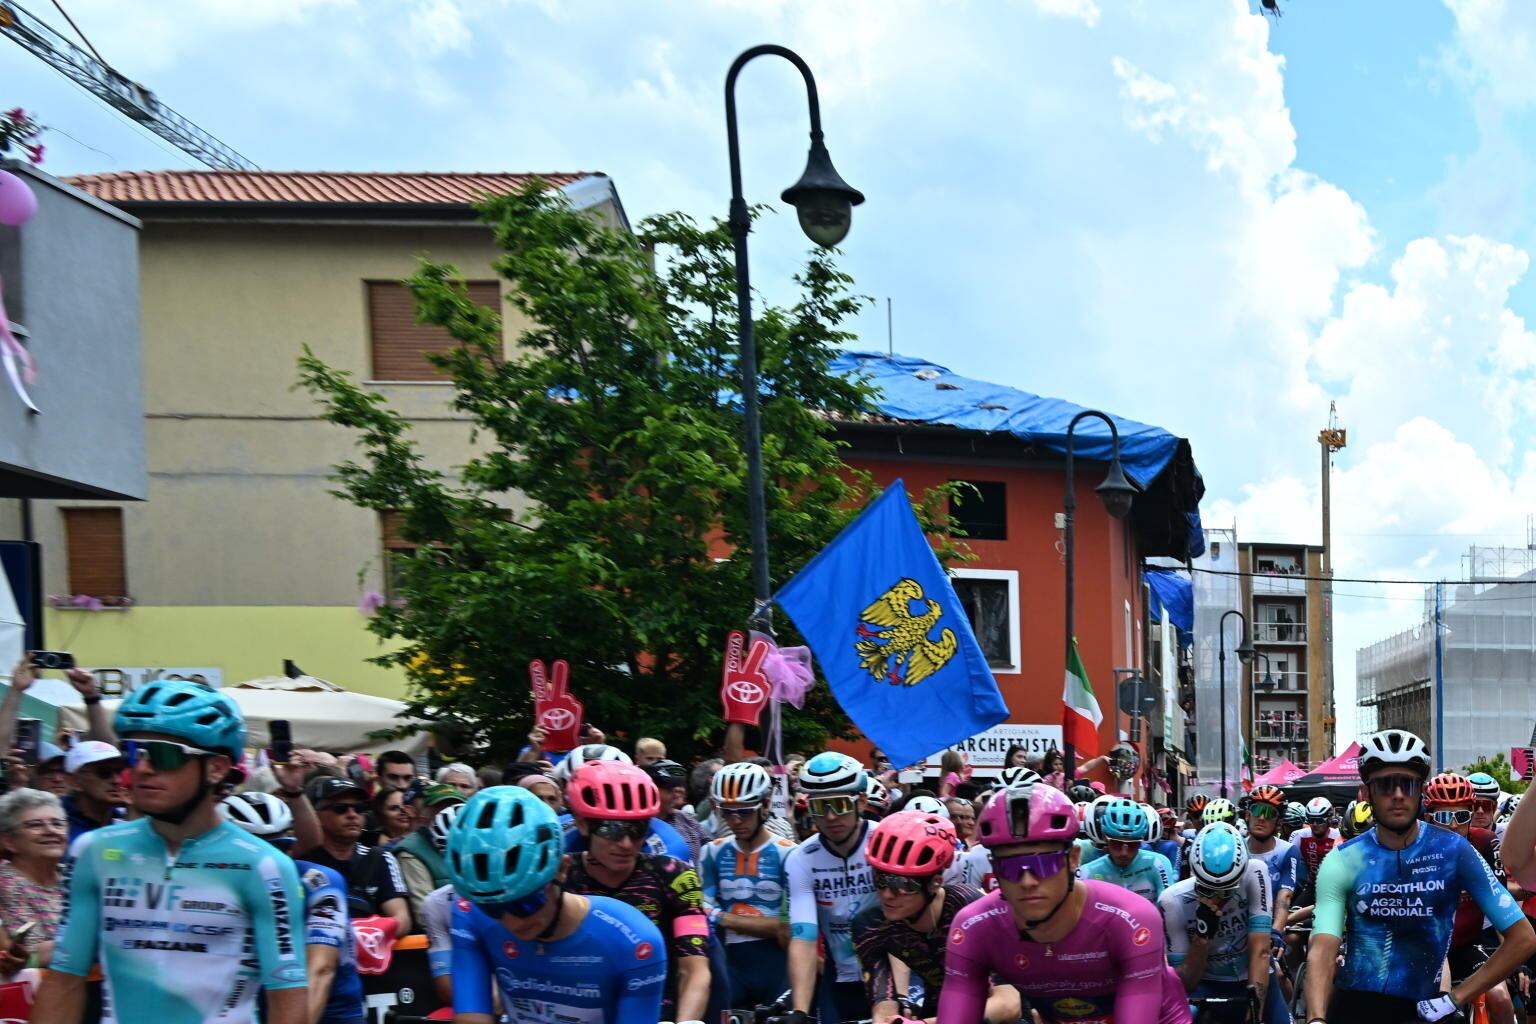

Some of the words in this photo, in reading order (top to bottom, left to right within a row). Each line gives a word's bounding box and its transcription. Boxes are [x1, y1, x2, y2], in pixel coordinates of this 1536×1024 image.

[728, 637, 743, 673] TOYOTA
[993, 728, 1040, 736] ARTIGIANA
[1405, 857, 1421, 865] VAN
[1422, 853, 1444, 862] RYSEL
[1290, 857, 1298, 884] GIANT
[1254, 869, 1268, 912] MERIDA
[1371, 879, 1445, 894] DECATHLON
[1371, 898, 1403, 907] AG2R
[1407, 897, 1424, 906] LA
[1370, 907, 1434, 917] MONDIALE
